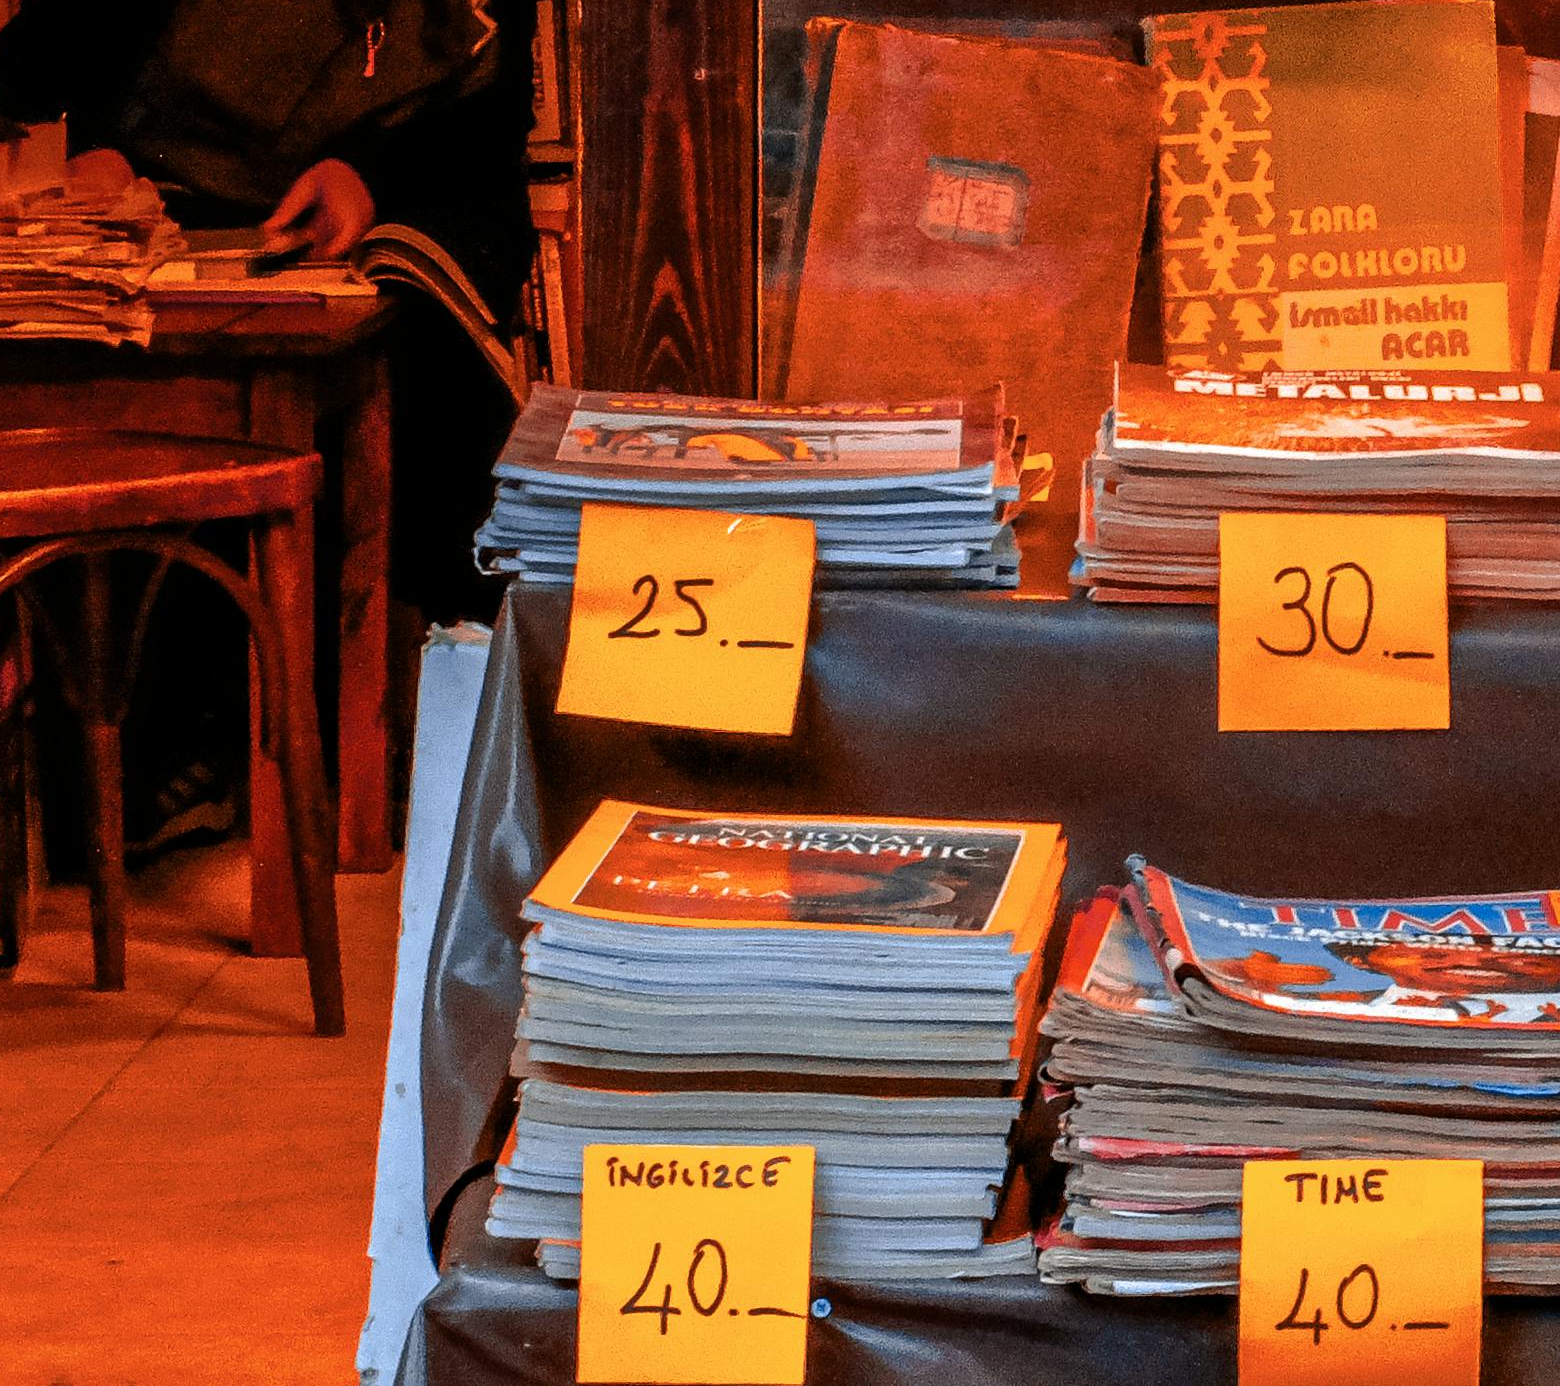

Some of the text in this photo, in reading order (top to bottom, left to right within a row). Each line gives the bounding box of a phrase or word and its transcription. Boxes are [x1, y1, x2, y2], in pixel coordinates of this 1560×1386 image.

[1382, 331, 1471, 359] ACAR
[647, 829, 990, 861] GEOGRAPHIC
[1284, 1169, 1389, 1204] TIME
